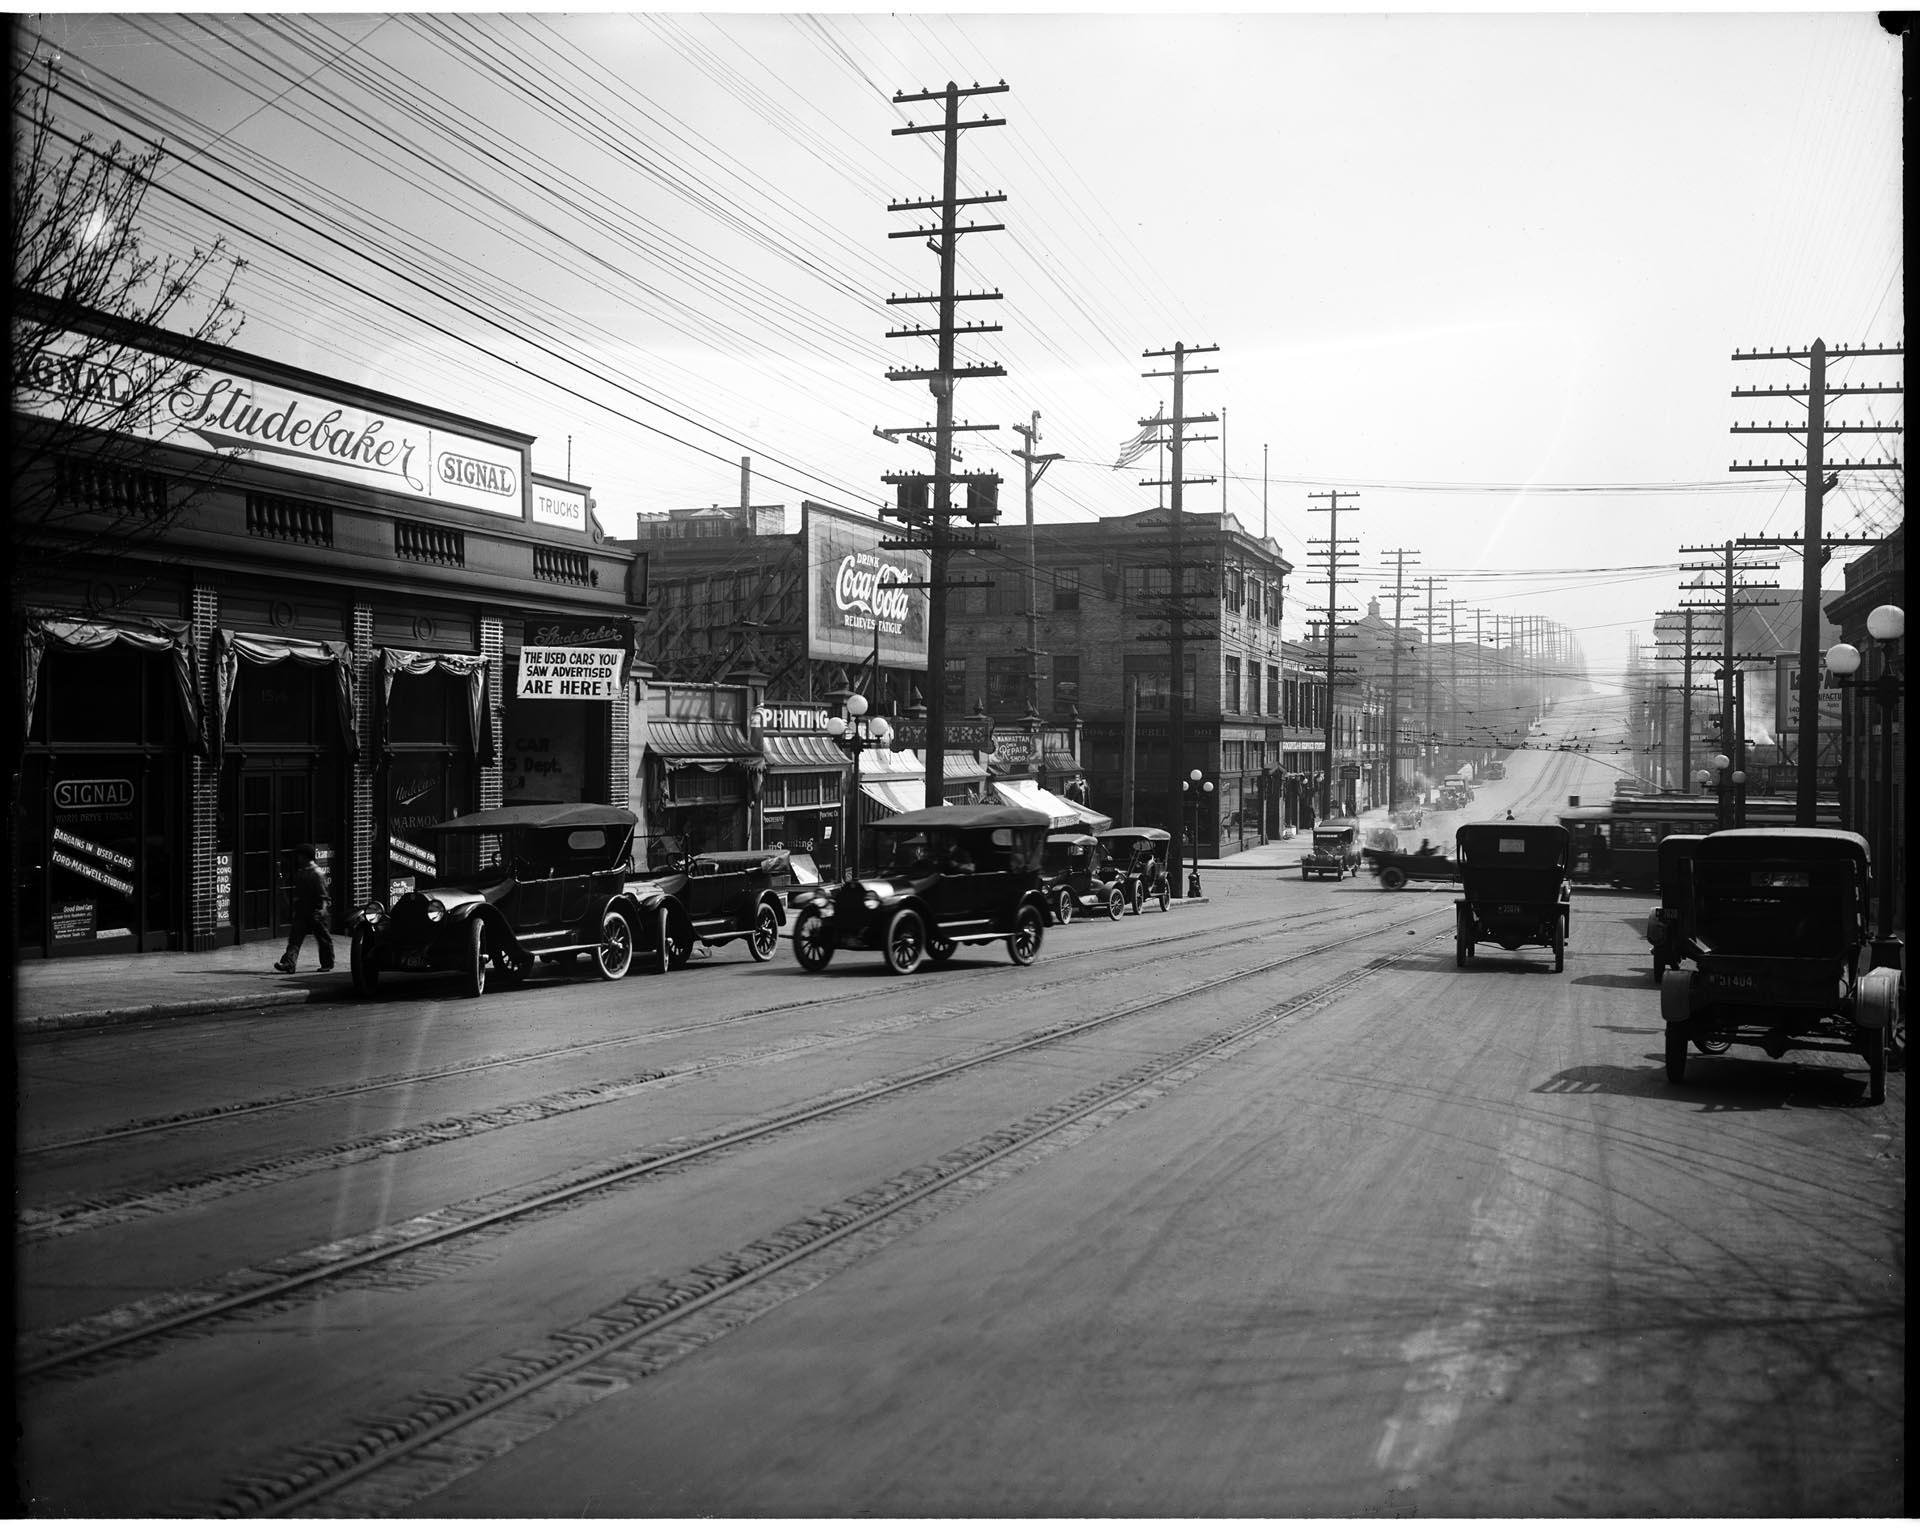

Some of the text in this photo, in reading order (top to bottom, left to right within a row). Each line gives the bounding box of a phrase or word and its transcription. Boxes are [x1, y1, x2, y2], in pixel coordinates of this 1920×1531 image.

[167, 369, 424, 492] Studebaker
[444, 457, 511, 492] SIGNAL
[539, 497, 580, 519] TRUCKS
[857, 553, 880, 567] DRINK
[844, 615, 876, 630] RELIEVES
[878, 621, 903, 634] FATIGUE
[534, 625, 623, 647] Studebaker
[525, 652, 618, 666] THE USED CARS YOU
[527, 666, 612, 678] SAW ADVERTISED
[523, 680, 553, 695] ARE
[560, 680, 602, 696] HERE
[763, 708, 829, 730] PRINTING
[899, 726, 986, 745] OYERS
[997, 735, 1030, 743] MANHATTAN
[999, 744, 1029, 761] REPAIR
[524, 756, 562, 777] Dept.
[60, 783, 129, 805] SIGNAL
[54, 828, 133, 868] BARGAINS IN USED CARS
